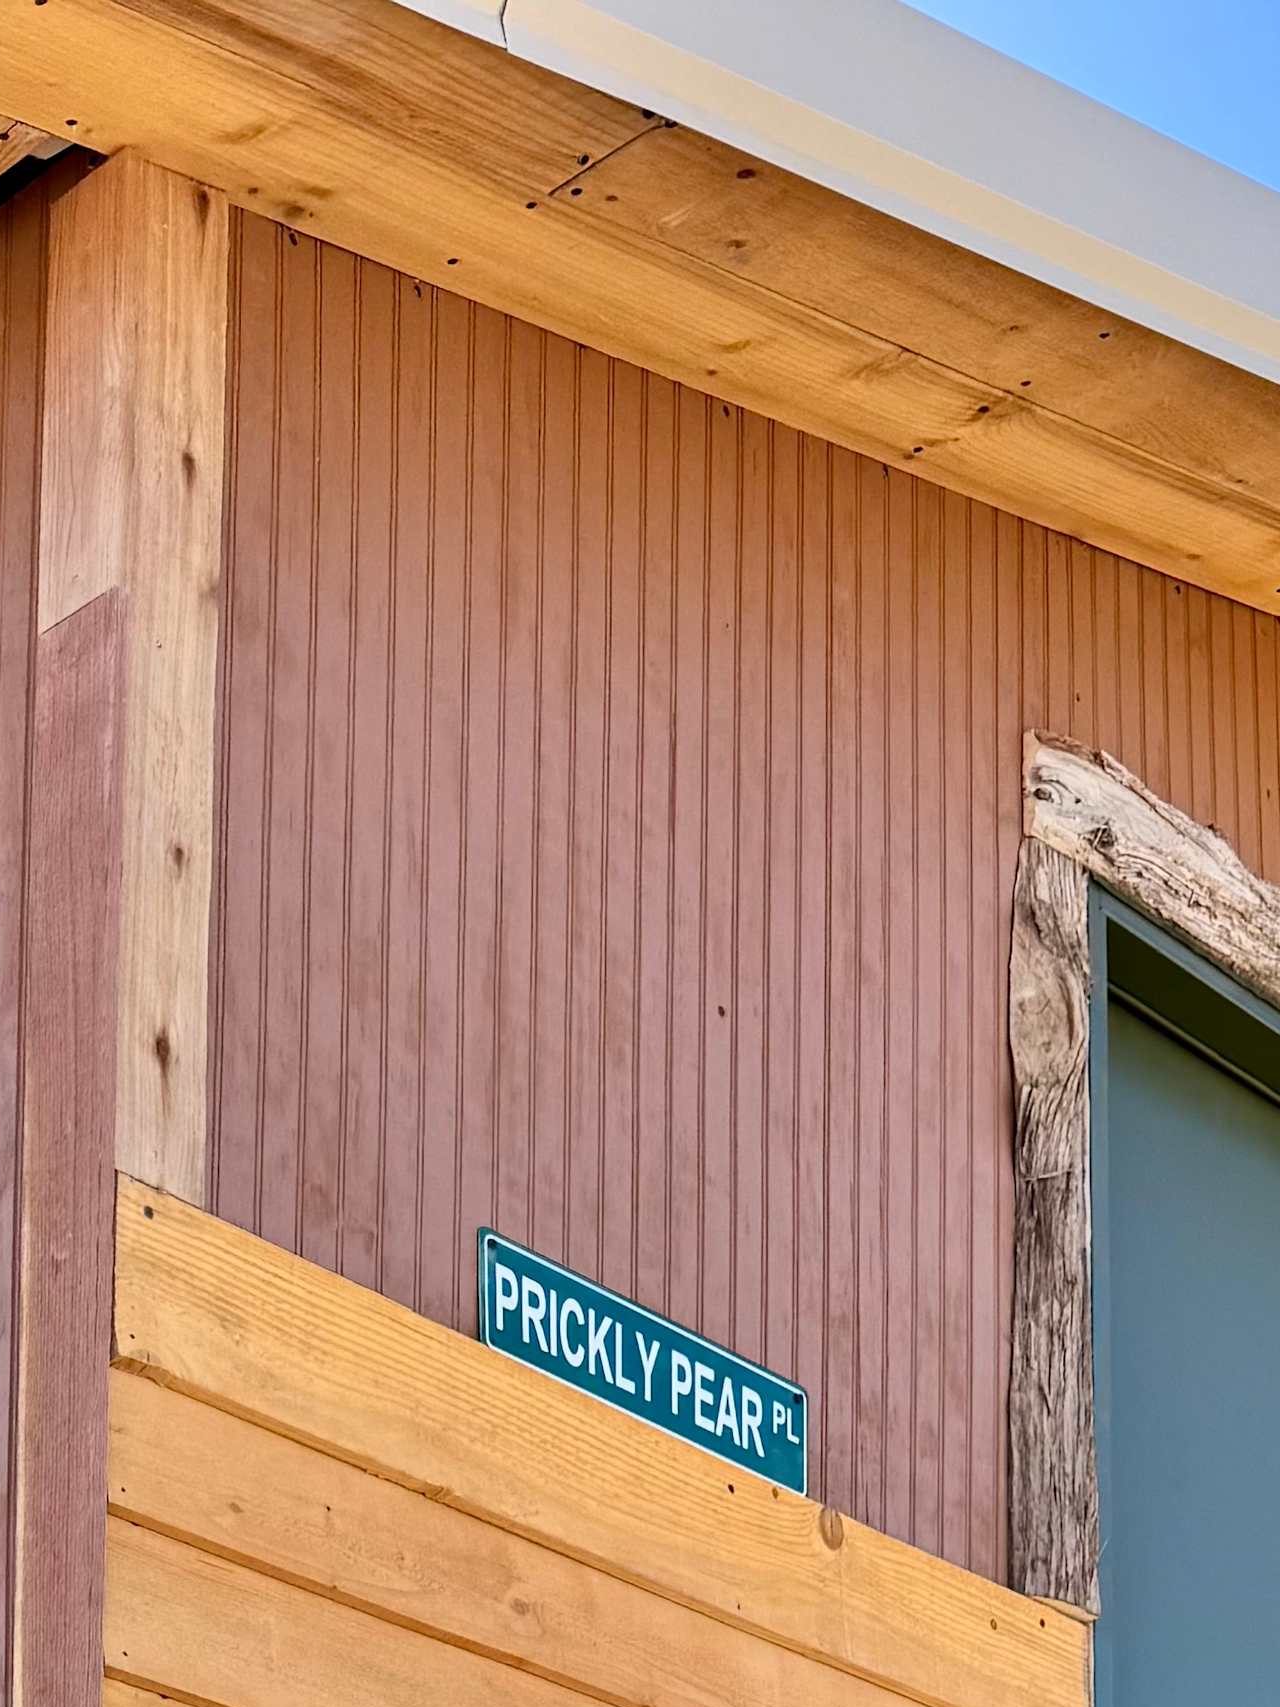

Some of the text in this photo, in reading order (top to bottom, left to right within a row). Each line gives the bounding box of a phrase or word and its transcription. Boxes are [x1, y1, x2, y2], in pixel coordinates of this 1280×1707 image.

[495, 1262, 800, 1458] PRICKLY PEAR PL
